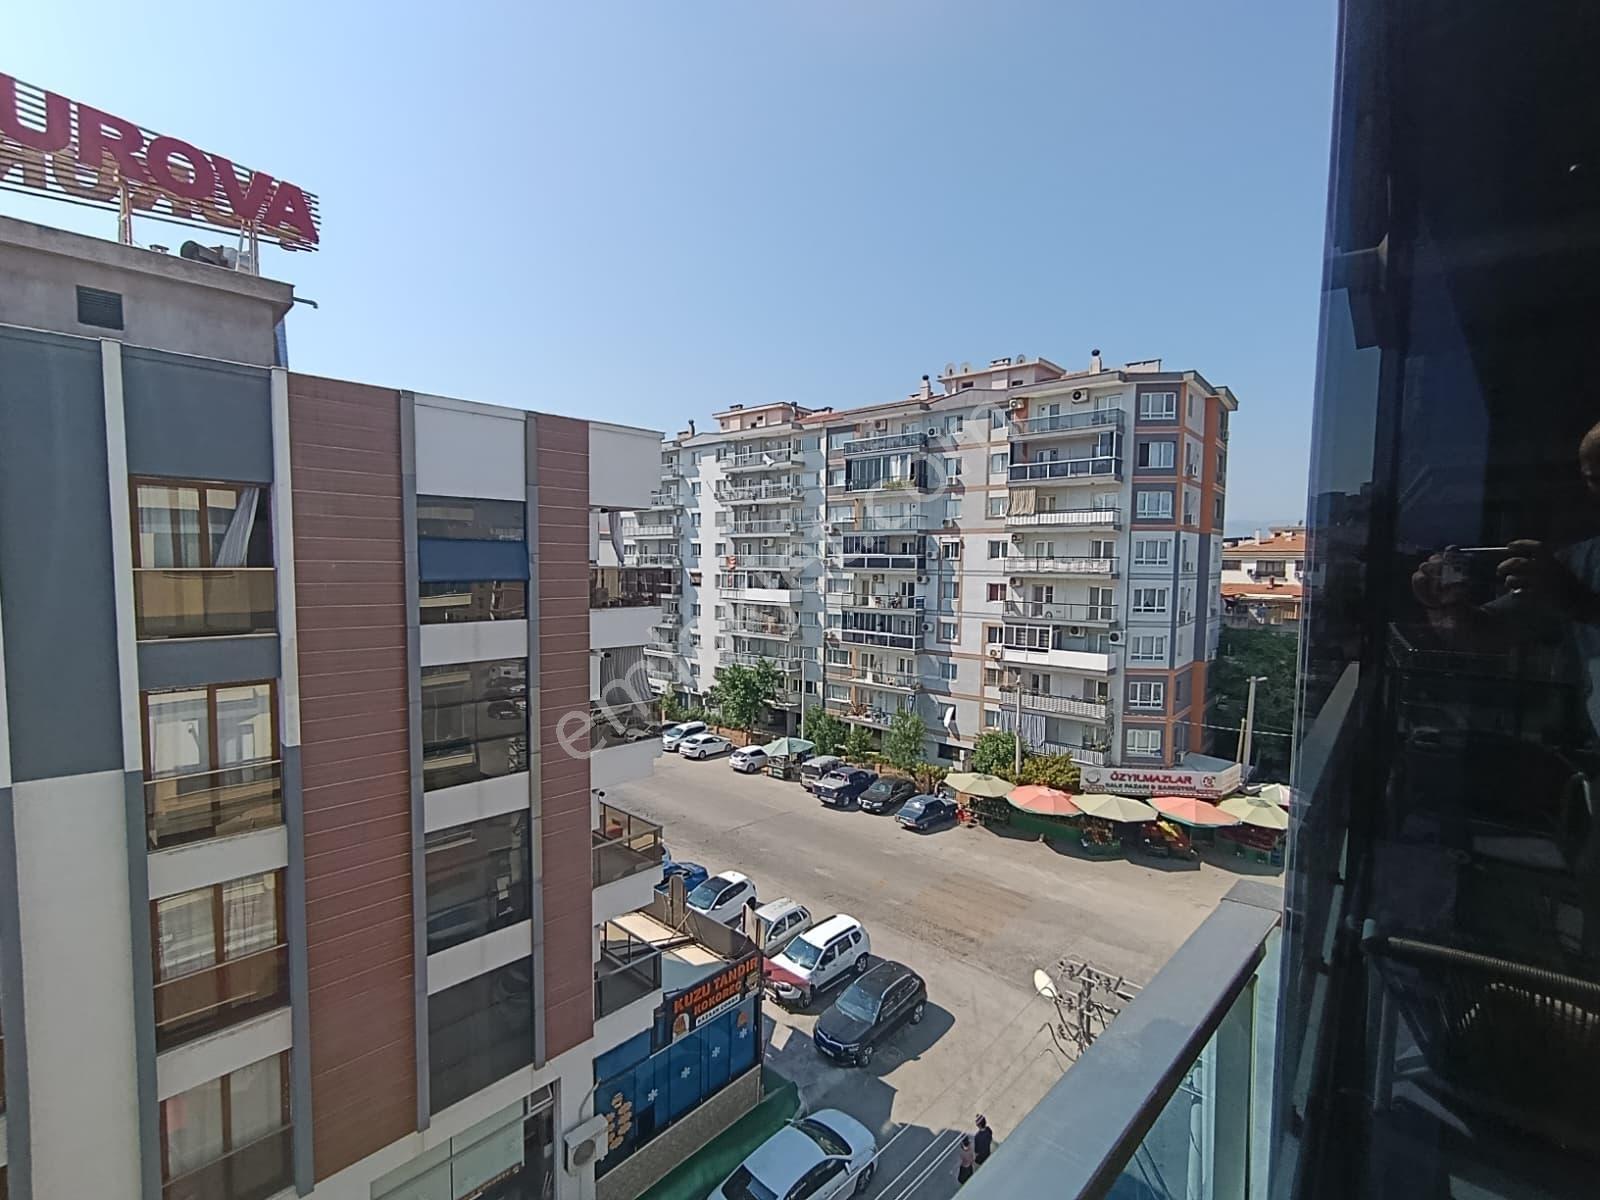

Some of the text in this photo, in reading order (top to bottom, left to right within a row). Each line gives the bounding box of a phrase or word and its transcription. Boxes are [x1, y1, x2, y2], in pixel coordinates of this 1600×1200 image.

[1110, 771, 1192, 784] ÖZYILMAZLAR
[673, 981, 711, 1015] KUZU
[713, 956, 759, 990] TANDIR
